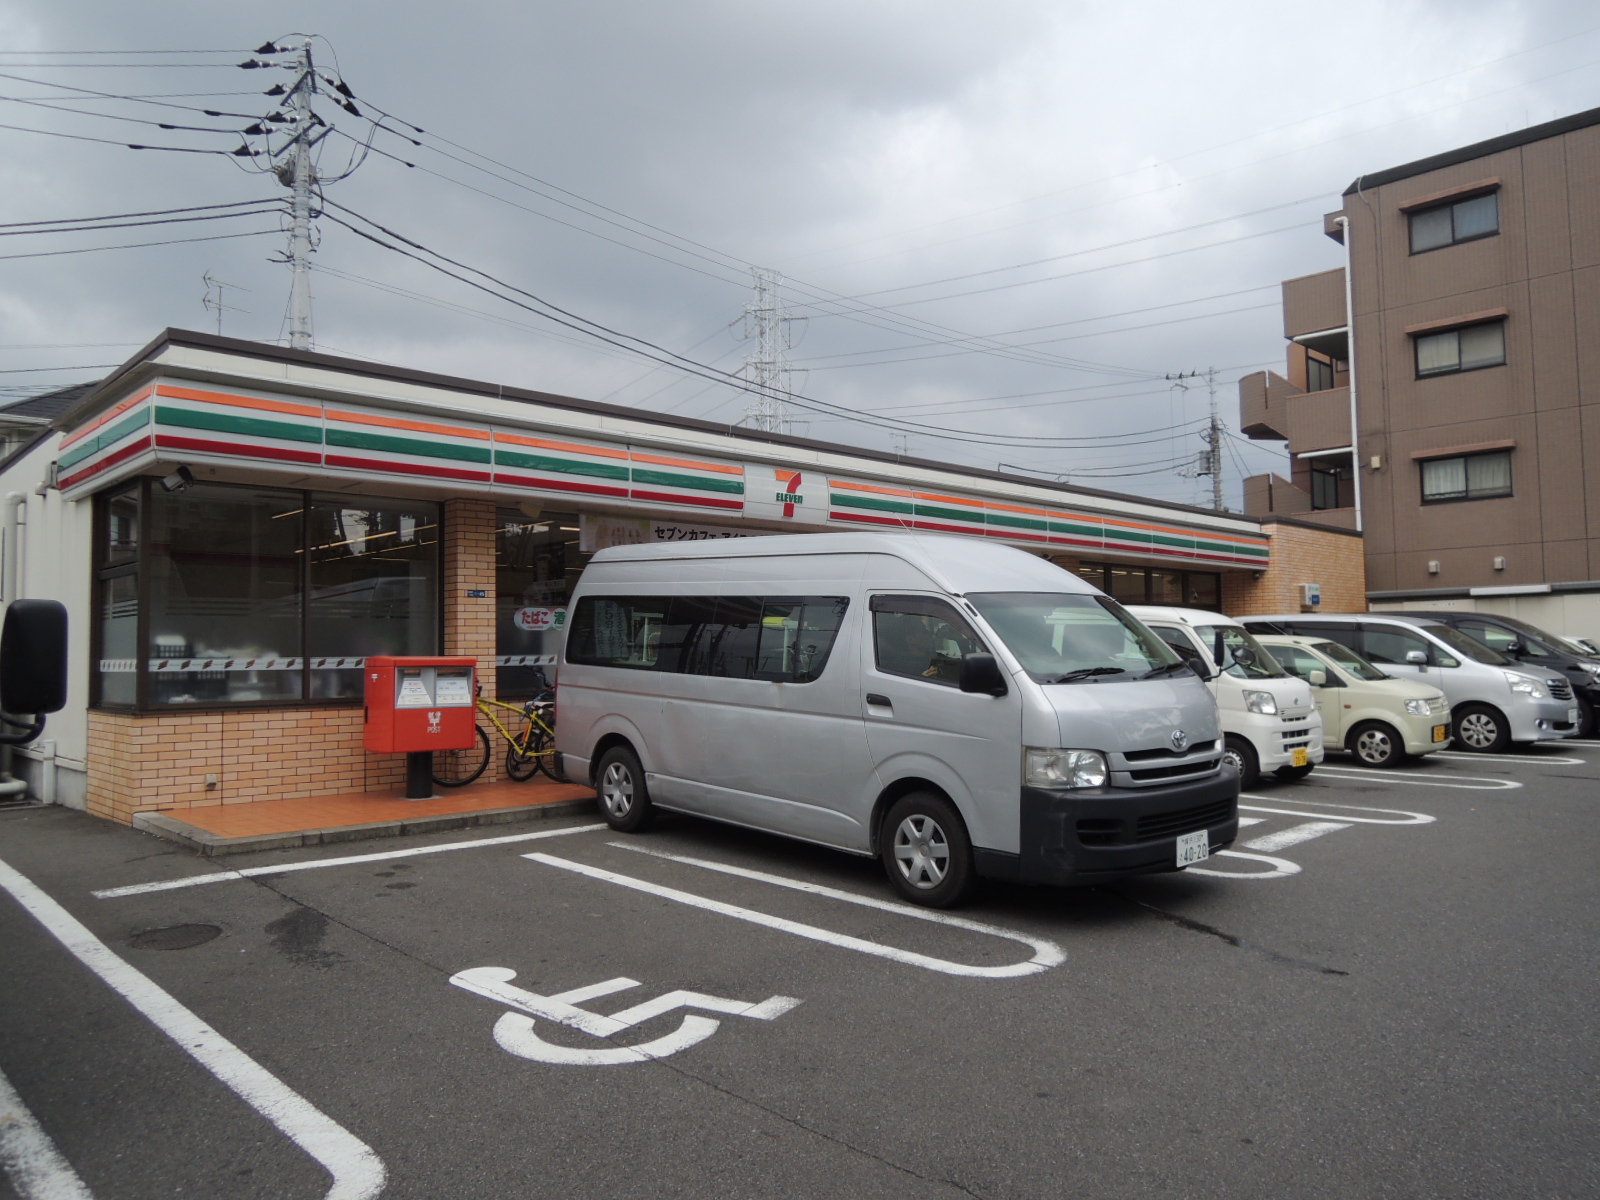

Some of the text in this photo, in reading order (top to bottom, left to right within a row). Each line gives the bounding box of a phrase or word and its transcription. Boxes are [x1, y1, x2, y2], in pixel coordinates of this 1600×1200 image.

[521, 611, 550, 625] たばこ
[427, 726, 441, 734] POST
[1184, 843, 1207, 862] 40-20
